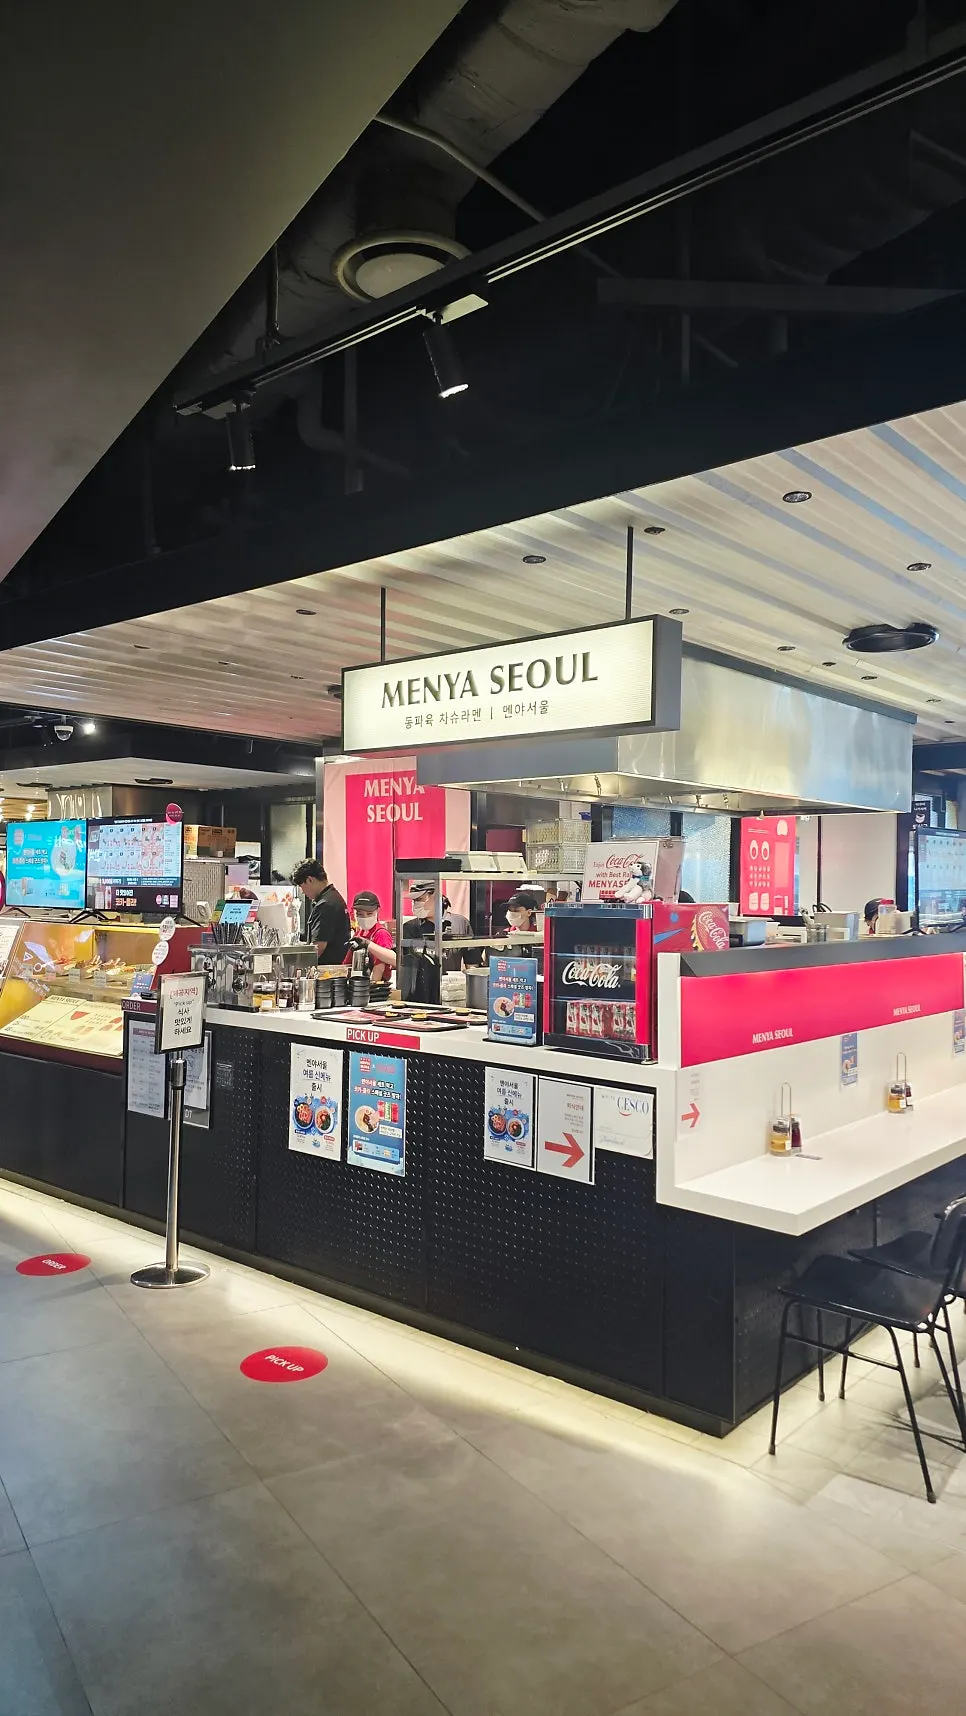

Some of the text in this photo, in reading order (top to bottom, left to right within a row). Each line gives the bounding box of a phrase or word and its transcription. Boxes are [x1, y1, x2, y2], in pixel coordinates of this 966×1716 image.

[381, 652, 598, 709] MENYA SEOUL
[404, 700, 550, 730] 동파육 차슈라멘 멘야서울
[364, 776, 425, 798] MENYA
[367, 802, 423, 823] SEOUL
[562, 961, 622, 989] Coca-Cola
[122, 1000, 141, 1011] ORDER
[178, 1007, 190, 1016] 식사
[174, 1025, 192, 1036] 하세요
[347, 1029, 380, 1043] PICK UP
[752, 1028, 794, 1044] MENYA SEOUL
[302, 1068, 332, 1082] 여름 신메뉴
[311, 1082, 323, 1092] 출시
[617, 1096, 650, 1113] CESCO
[41, 1259, 67, 1270] ORDER
[265, 1354, 305, 1373] PICK UP
